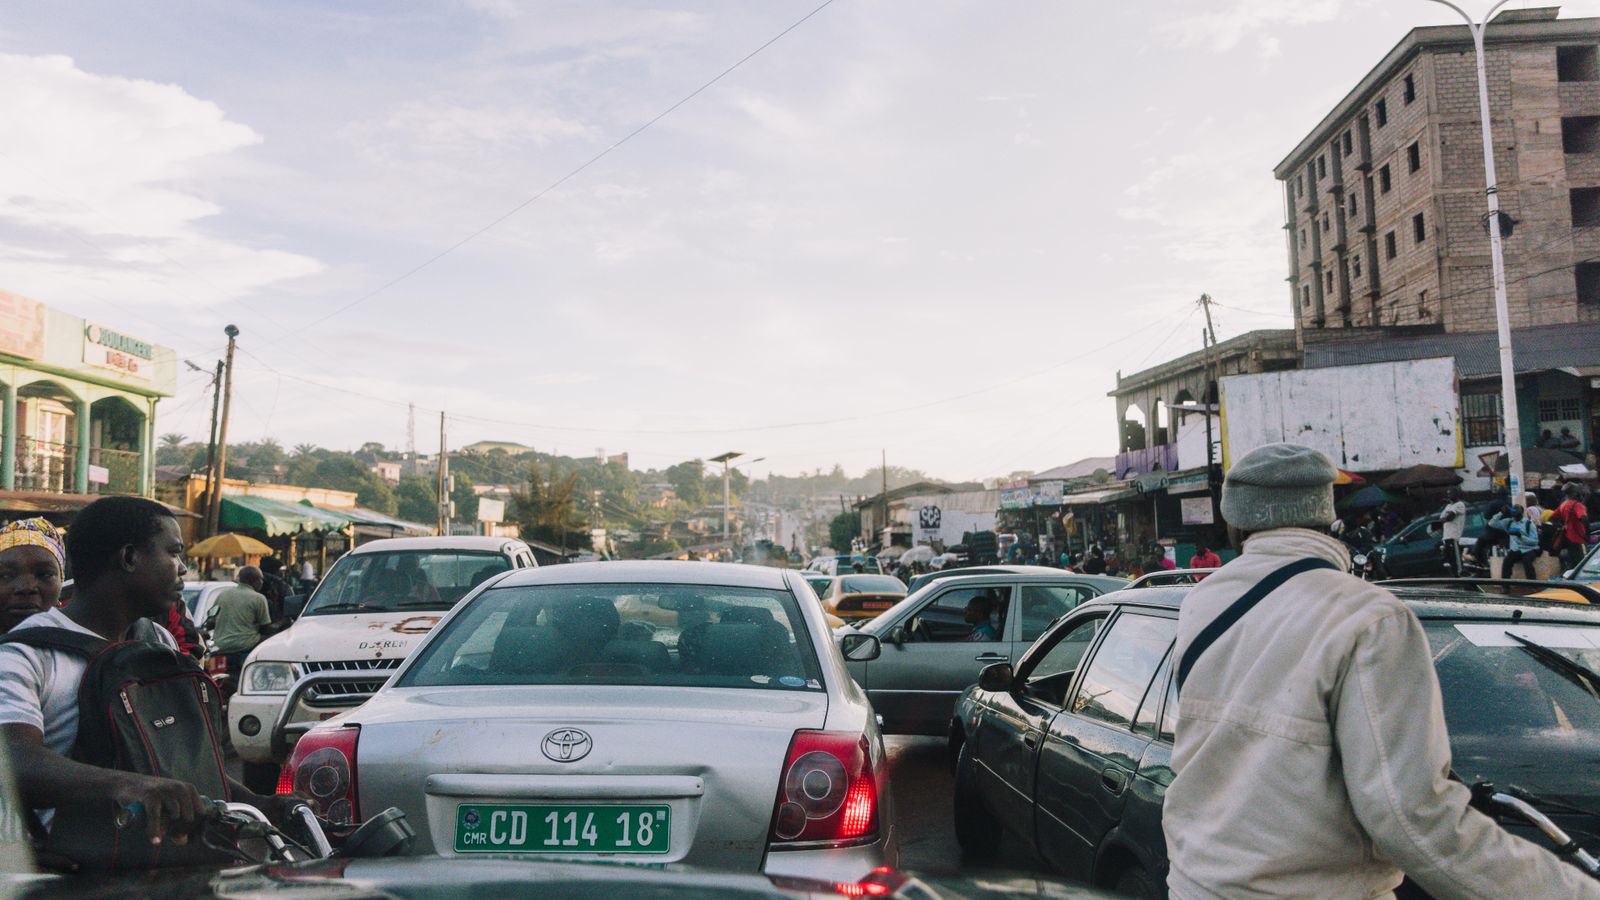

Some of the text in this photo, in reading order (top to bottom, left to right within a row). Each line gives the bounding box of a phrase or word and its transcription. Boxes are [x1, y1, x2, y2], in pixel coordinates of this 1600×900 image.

[463, 832, 487, 845] CMR
[489, 811, 654, 847] CD 114 18
